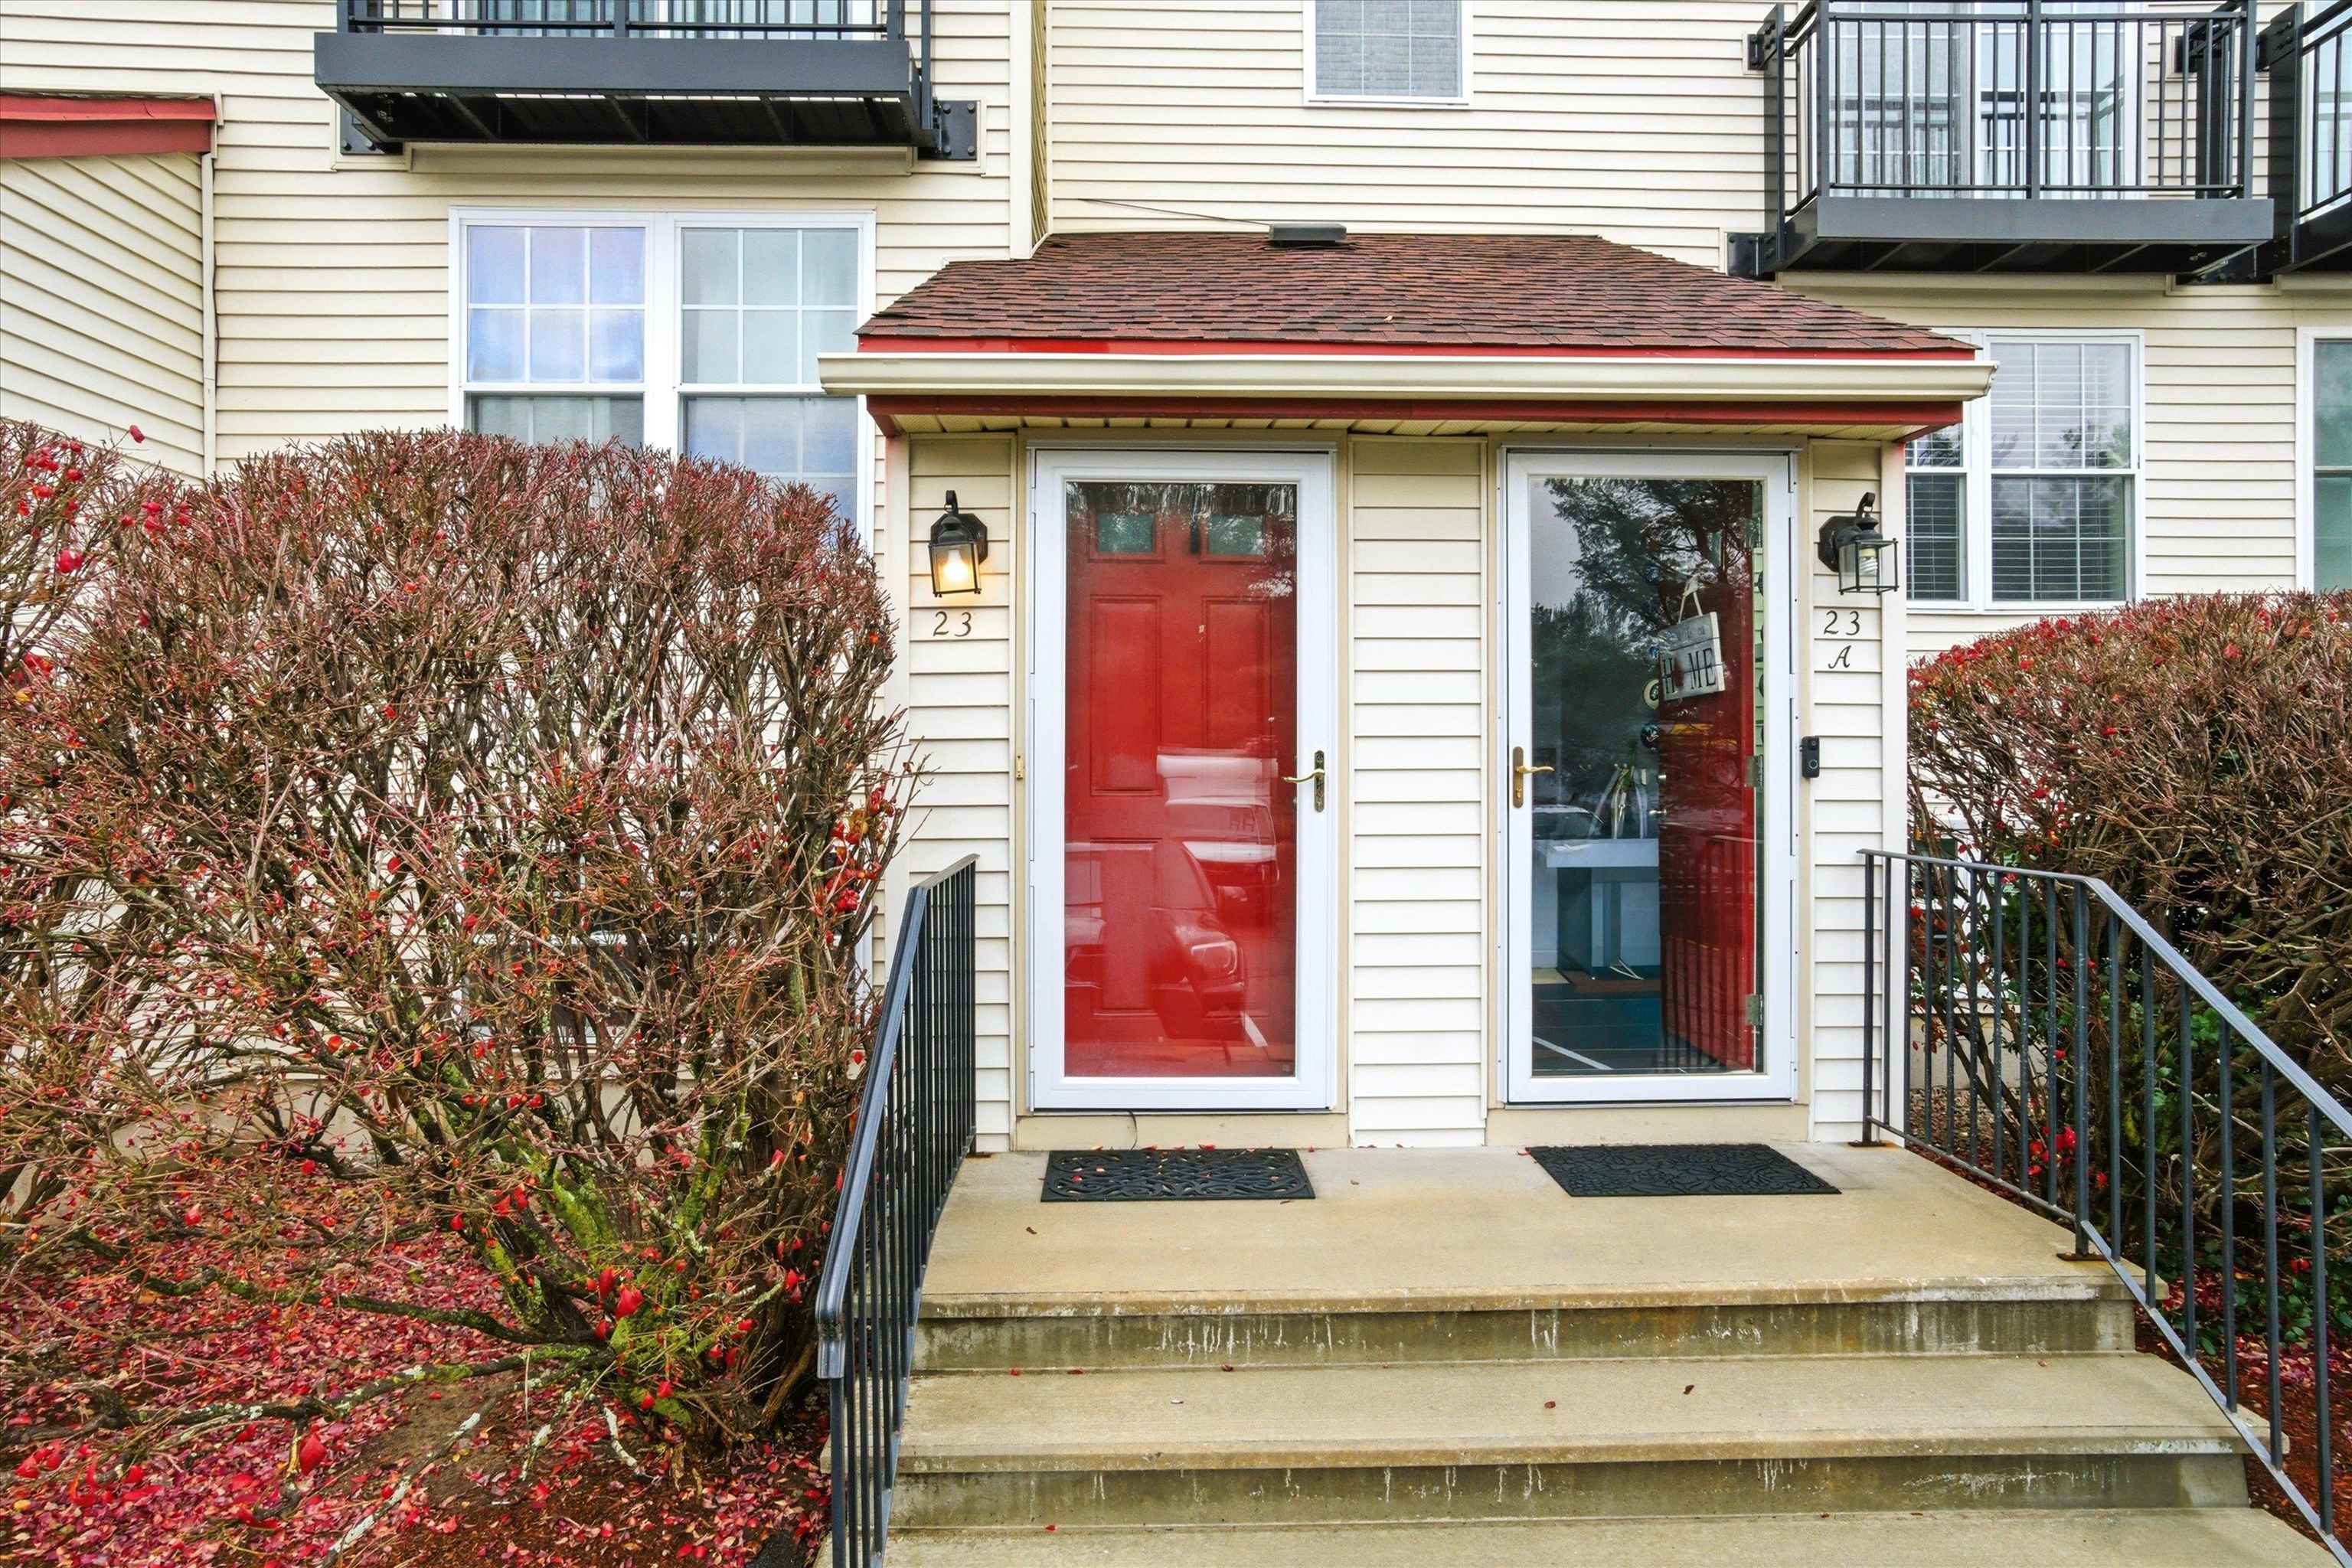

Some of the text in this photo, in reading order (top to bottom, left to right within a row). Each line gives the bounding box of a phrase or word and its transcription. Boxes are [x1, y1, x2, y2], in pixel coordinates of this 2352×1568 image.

[933, 611, 972, 637] 23
[1824, 610, 1860, 635] 23
[1828, 645, 1851, 668] A
[1662, 648, 1717, 694] HME
